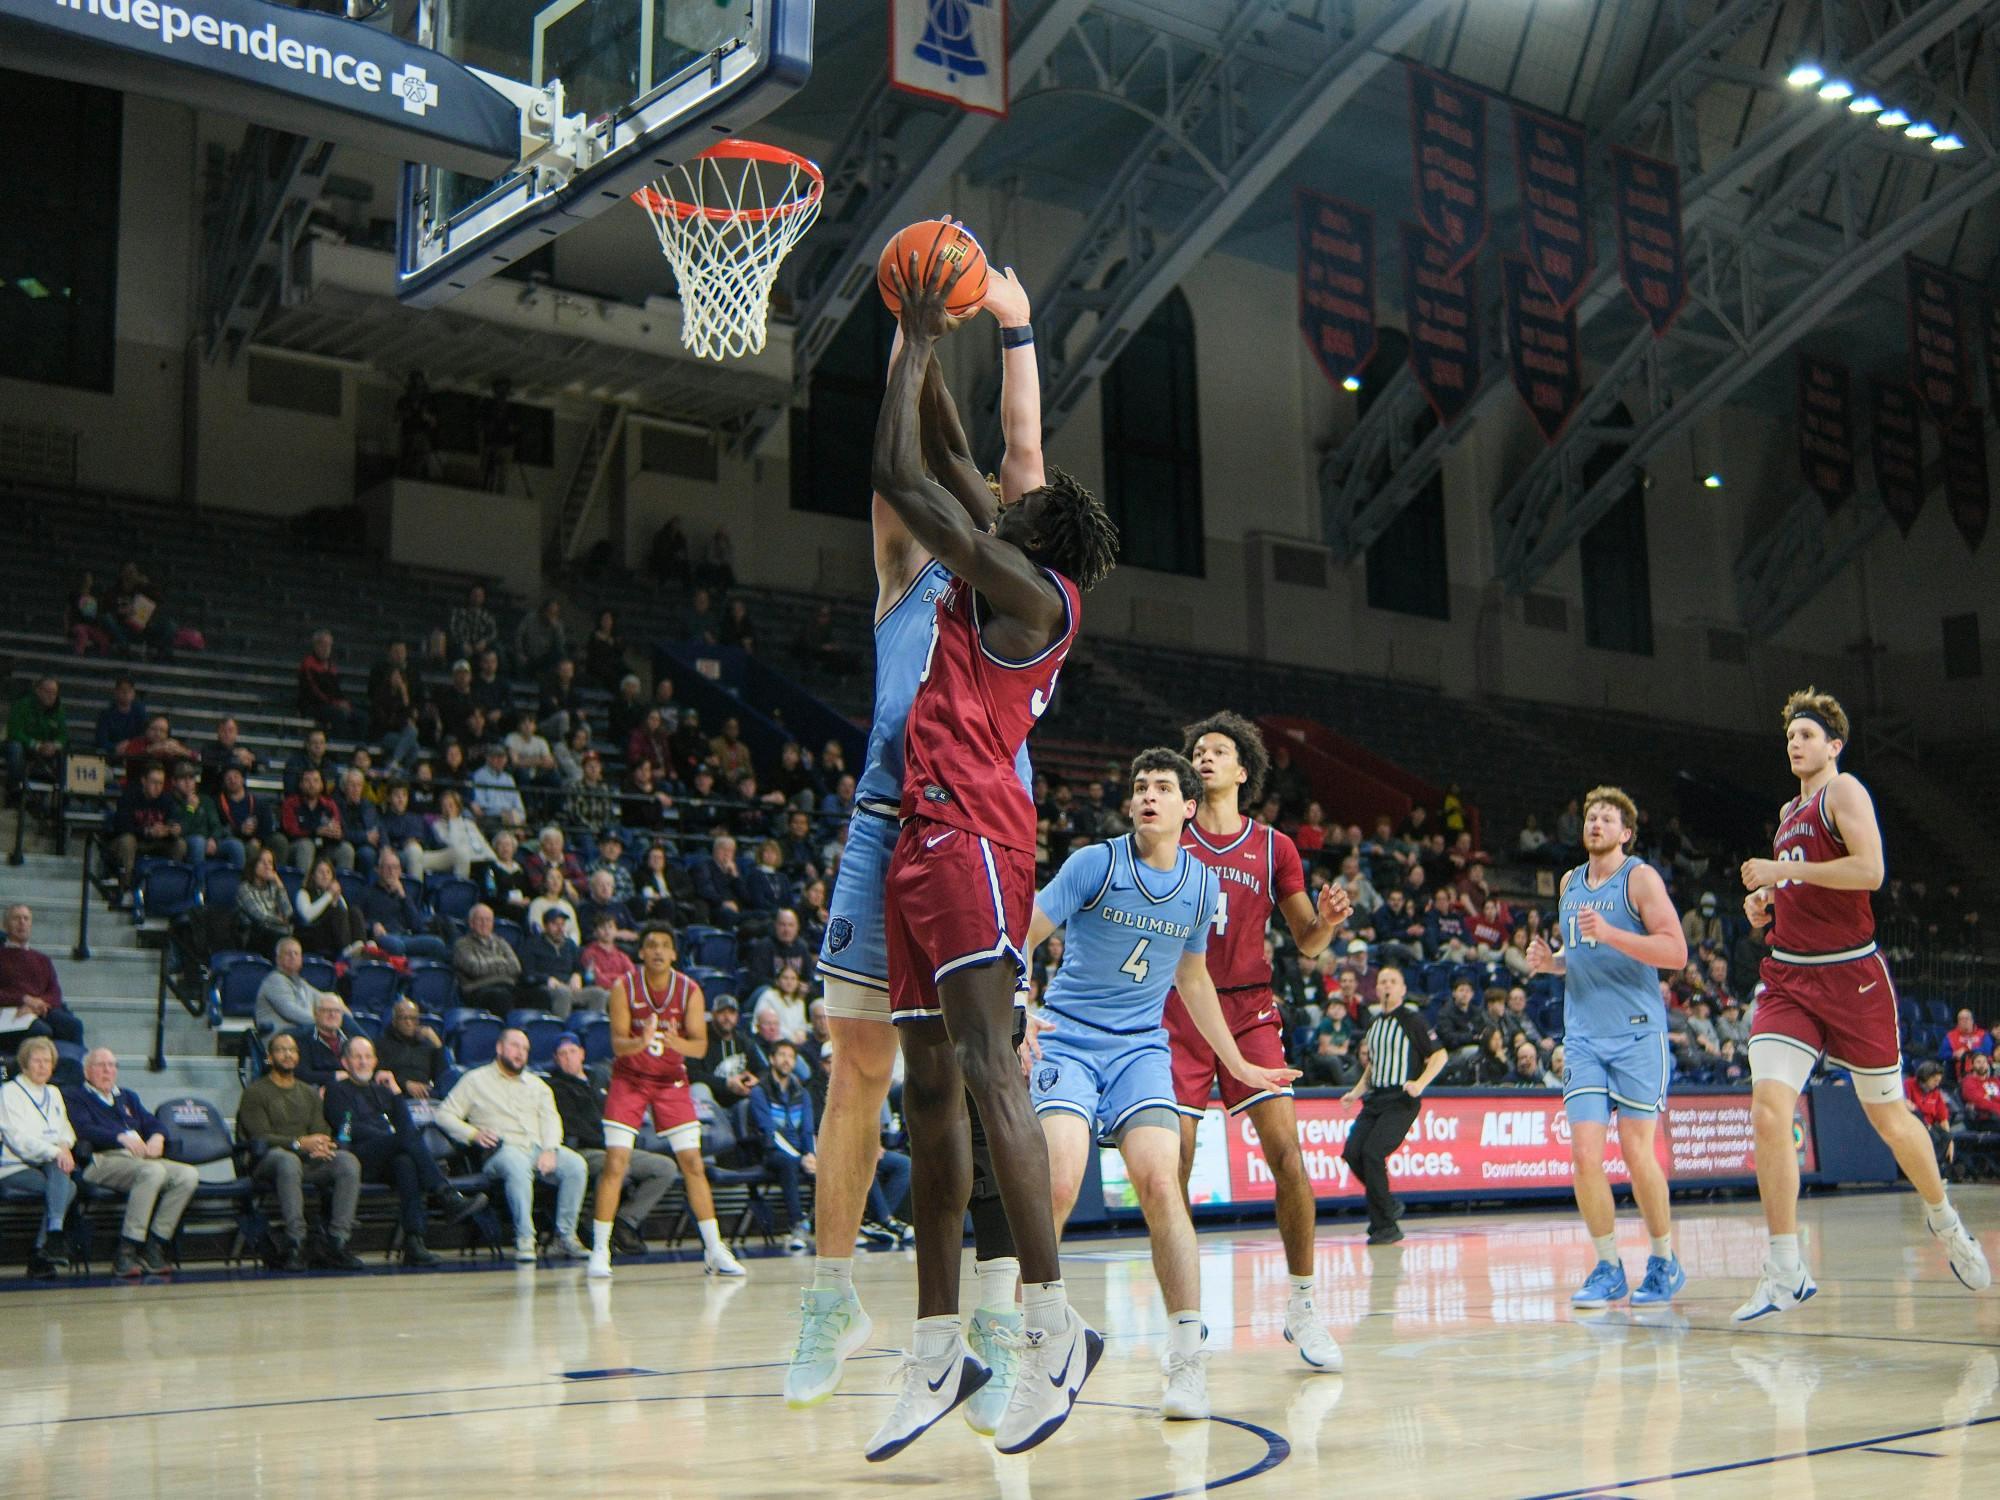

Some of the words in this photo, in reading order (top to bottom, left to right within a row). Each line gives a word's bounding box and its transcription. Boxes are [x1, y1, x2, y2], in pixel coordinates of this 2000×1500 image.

[1102, 905, 1190, 939] COLUMBIA
[1119, 936, 1151, 984] 4
[648, 1031, 665, 1057] 5
[1424, 1109, 1459, 1141] for
[1669, 1109, 1696, 1123] Reach
[1697, 1110, 1716, 1124] your
[1718, 1107, 1748, 1124] activity
[1670, 1124, 1690, 1138] with
[1691, 1124, 1716, 1140] Apple
[1717, 1123, 1744, 1137] Watch
[1672, 1140, 1690, 1154] and
[1691, 1141, 1706, 1156] get
[1707, 1138, 1748, 1152] rewarded
[1481, 1161, 1546, 1178] Download
[1548, 1159, 1569, 1175] the
[1674, 1155, 1712, 1172] Sincerely
